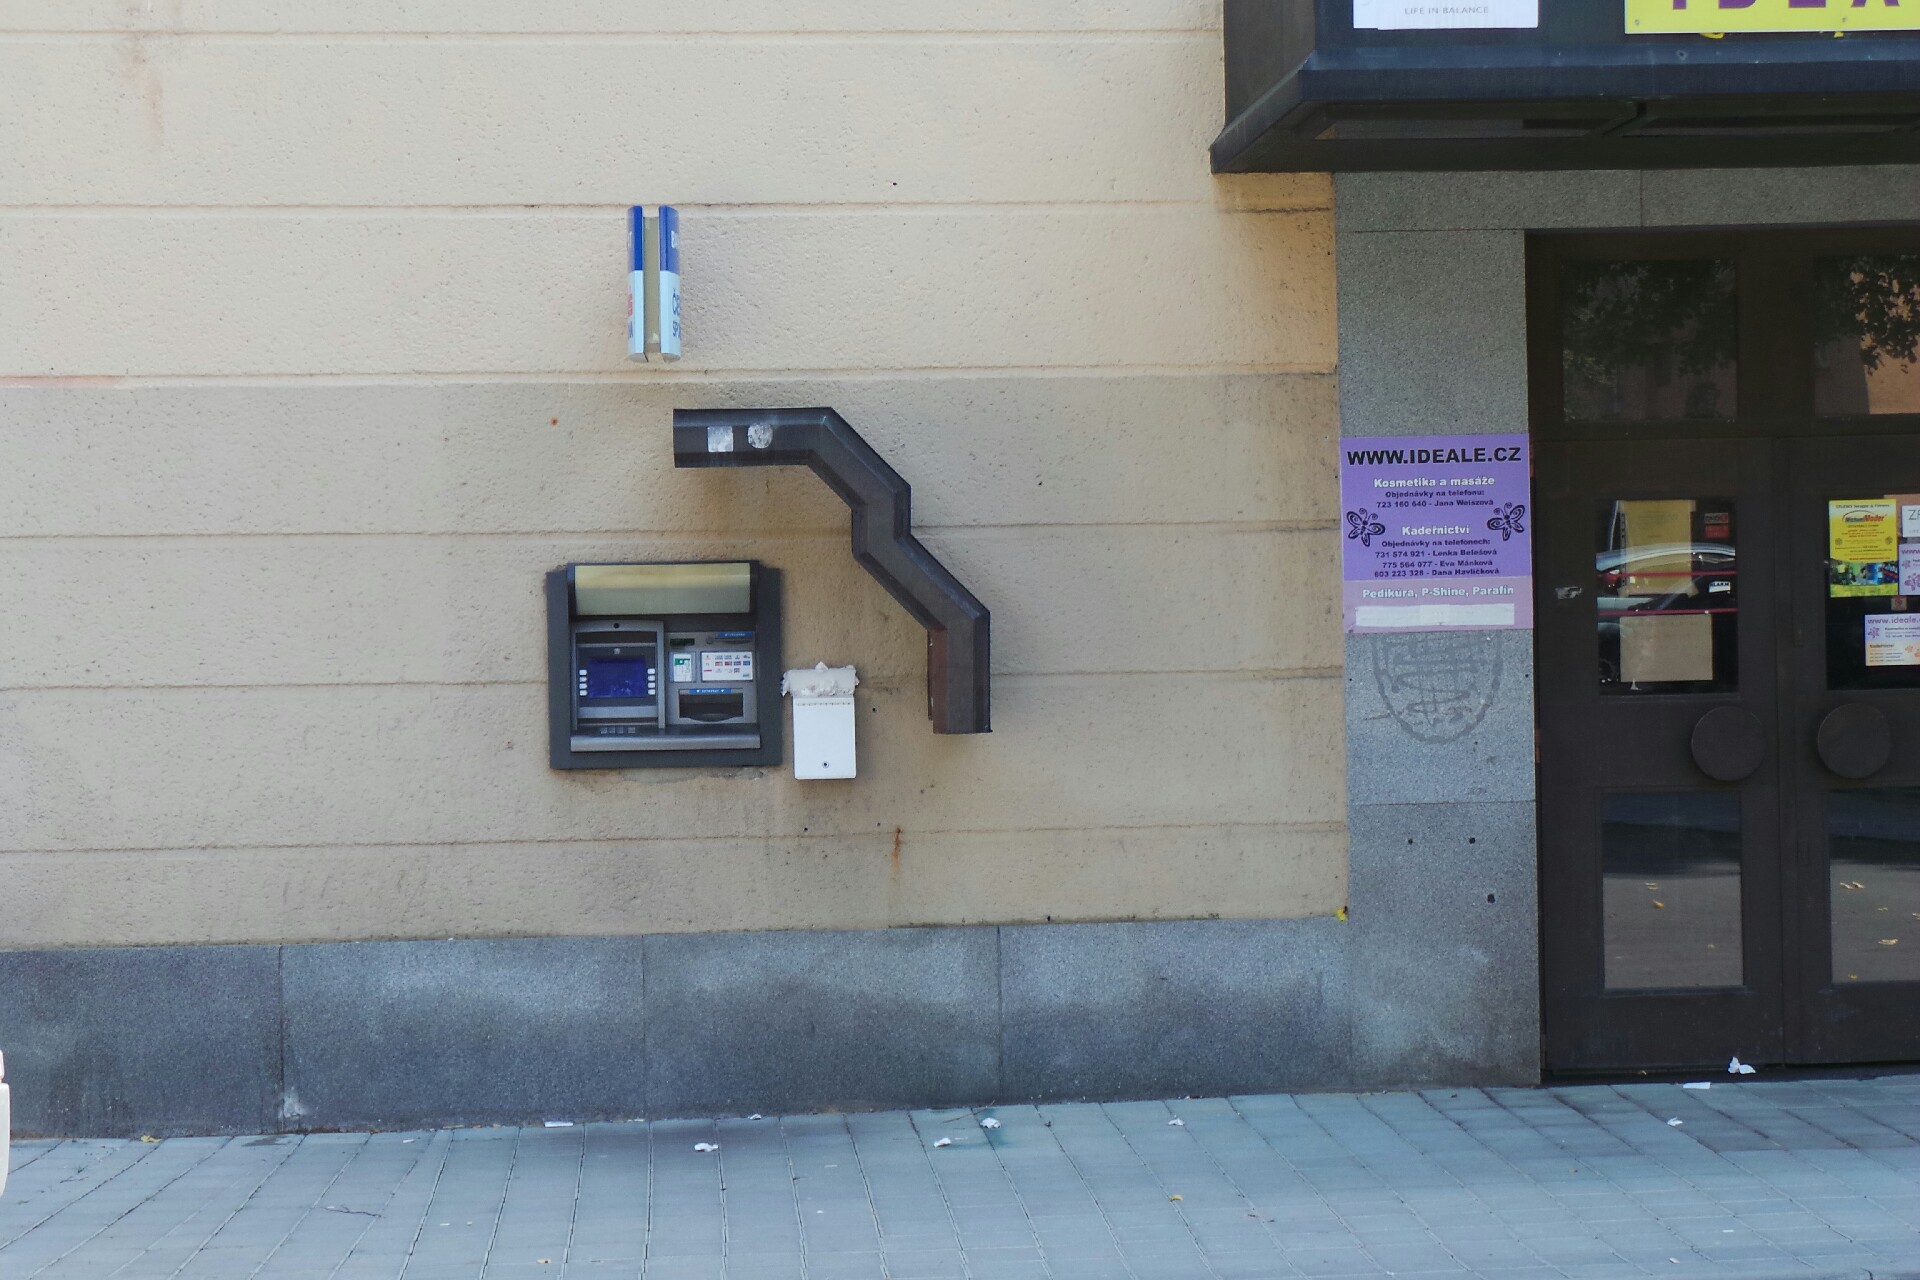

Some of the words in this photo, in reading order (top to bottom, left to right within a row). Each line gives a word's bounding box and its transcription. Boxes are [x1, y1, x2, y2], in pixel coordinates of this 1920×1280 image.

[1442, 6, 1489, 14] BALANCE
[1347, 447, 1521, 465] WWW.IDEALE.CZ
[1374, 478, 1436, 488] Kosmetika
[1450, 475, 1495, 486] masáže
[1385, 491, 1433, 499] Objednávky
[1402, 525, 1470, 536] Kadeřnictví
[1381, 540, 1430, 548] Objednávky
[1444, 538, 1491, 546] telefonech:
[1375, 551, 1390, 559] 731
[1374, 570, 1390, 578] 603
[1422, 586, 1469, 597] P-Shine,
[1868, 616, 1920, 624] www.ideale.
